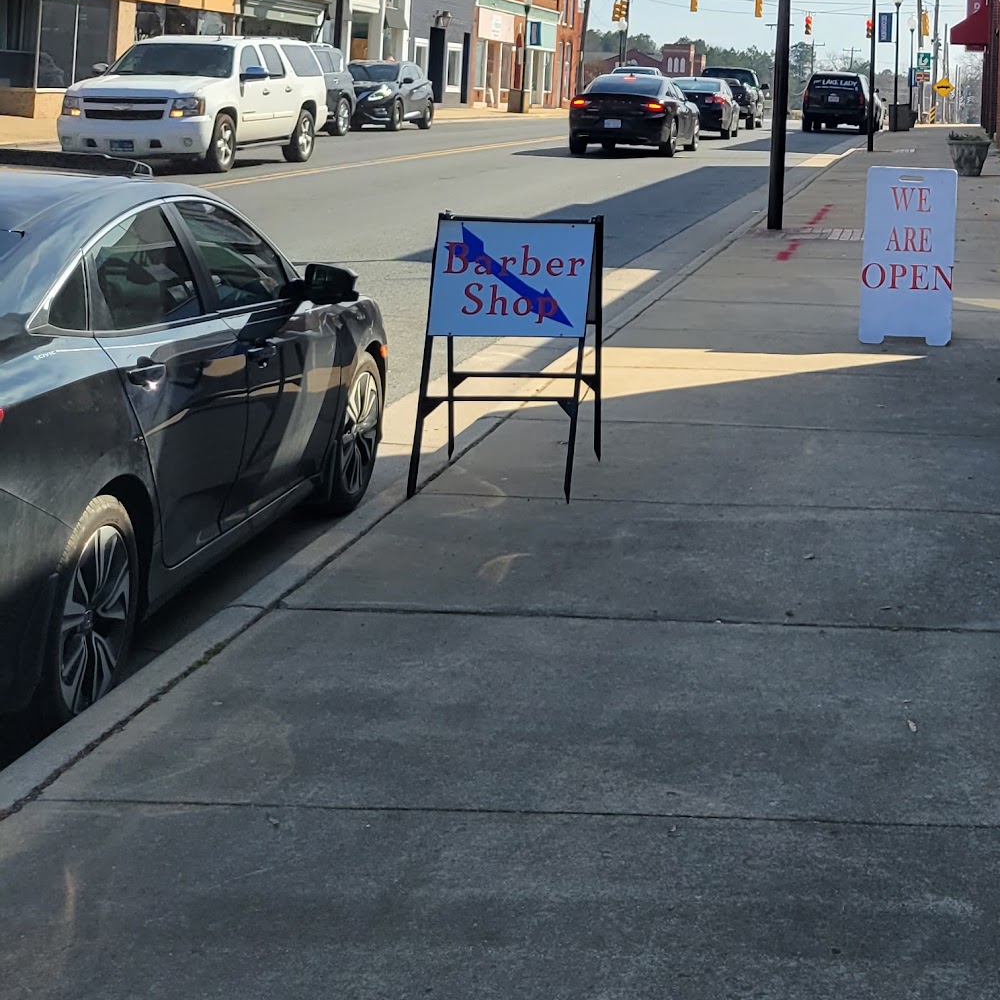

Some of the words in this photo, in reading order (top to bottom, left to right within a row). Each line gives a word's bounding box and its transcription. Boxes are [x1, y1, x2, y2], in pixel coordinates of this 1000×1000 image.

[973, 2, 981, 13] D
[890, 186, 932, 213] WE
[885, 226, 932, 252] ARE
[442, 241, 586, 277] Barber
[861, 262, 955, 291] OPEN
[461, 282, 559, 324] Shop
[38, 350, 57, 359] CIVIC
